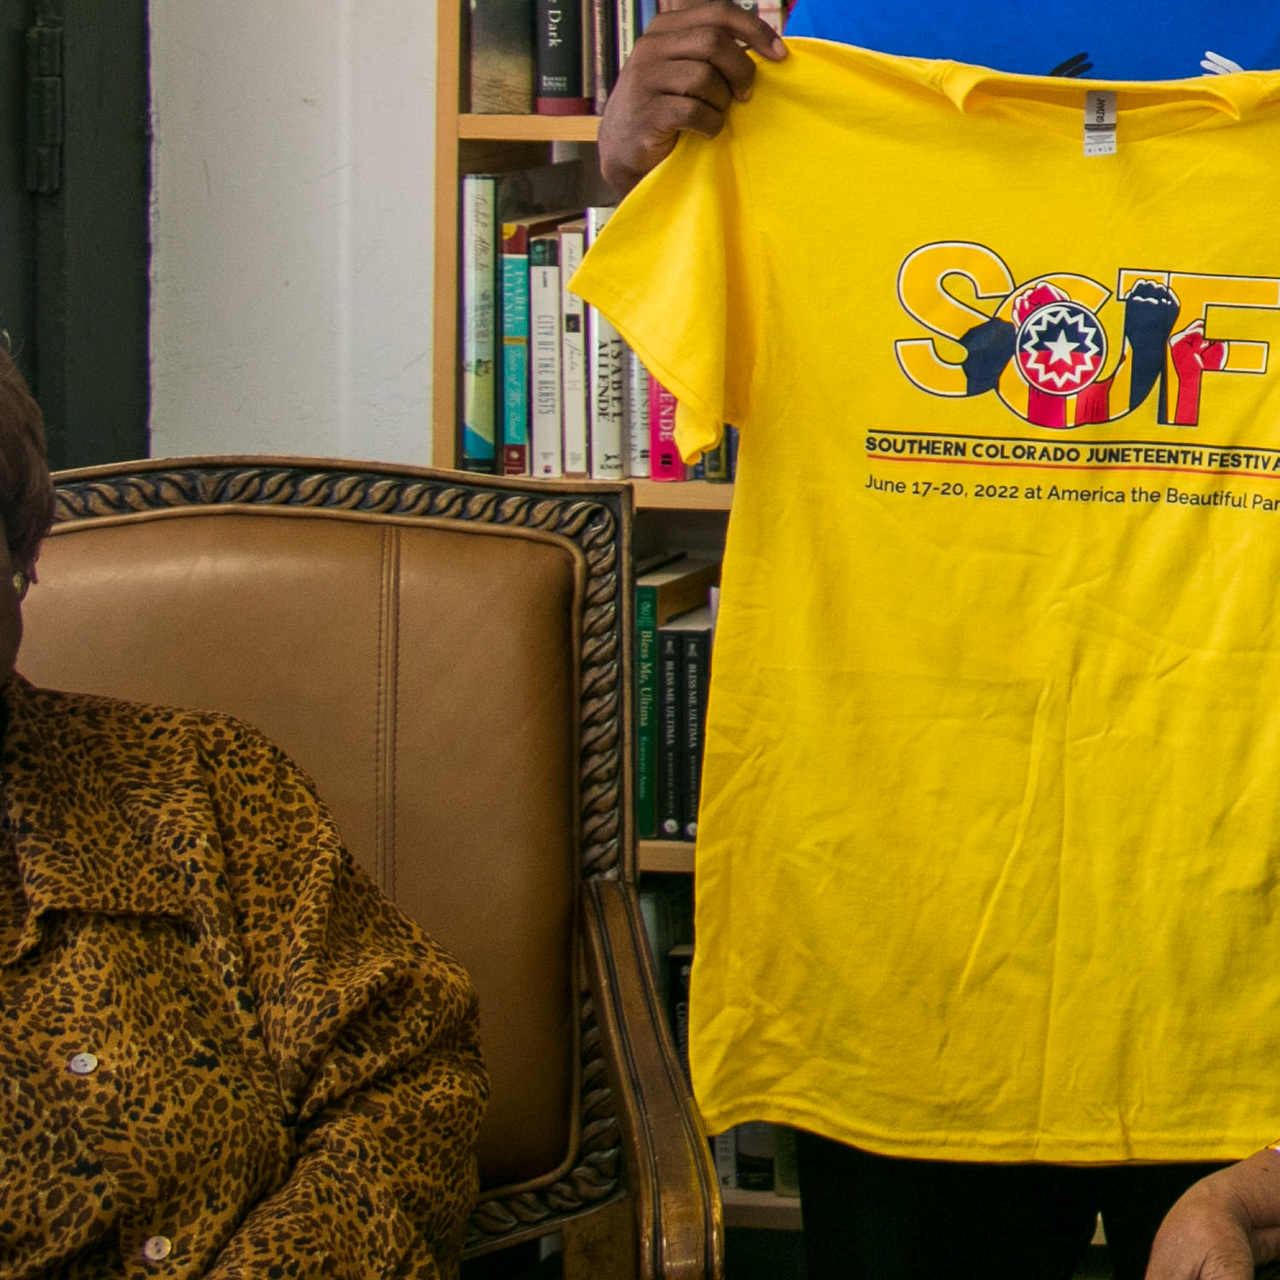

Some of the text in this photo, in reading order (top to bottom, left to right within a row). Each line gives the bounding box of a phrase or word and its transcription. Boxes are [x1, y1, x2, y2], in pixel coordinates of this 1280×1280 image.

[548, 9, 562, 48] Dark
[597, 340, 610, 423] ALLENDE
[610, 338, 623, 423] ISABEL
[865, 436, 968, 458] SOUTHERN
[972, 442, 1080, 462] COLORADO
[1086, 447, 1203, 466] JUNETEENTH
[864, 474, 907, 495] June
[911, 480, 970, 498] 17-20,
[974, 484, 1019, 500] 2022
[1023, 485, 1044, 501] at
[1047, 485, 1127, 504] America
[1130, 487, 1162, 504] the
[1166, 488, 1248, 510] Beautiful
